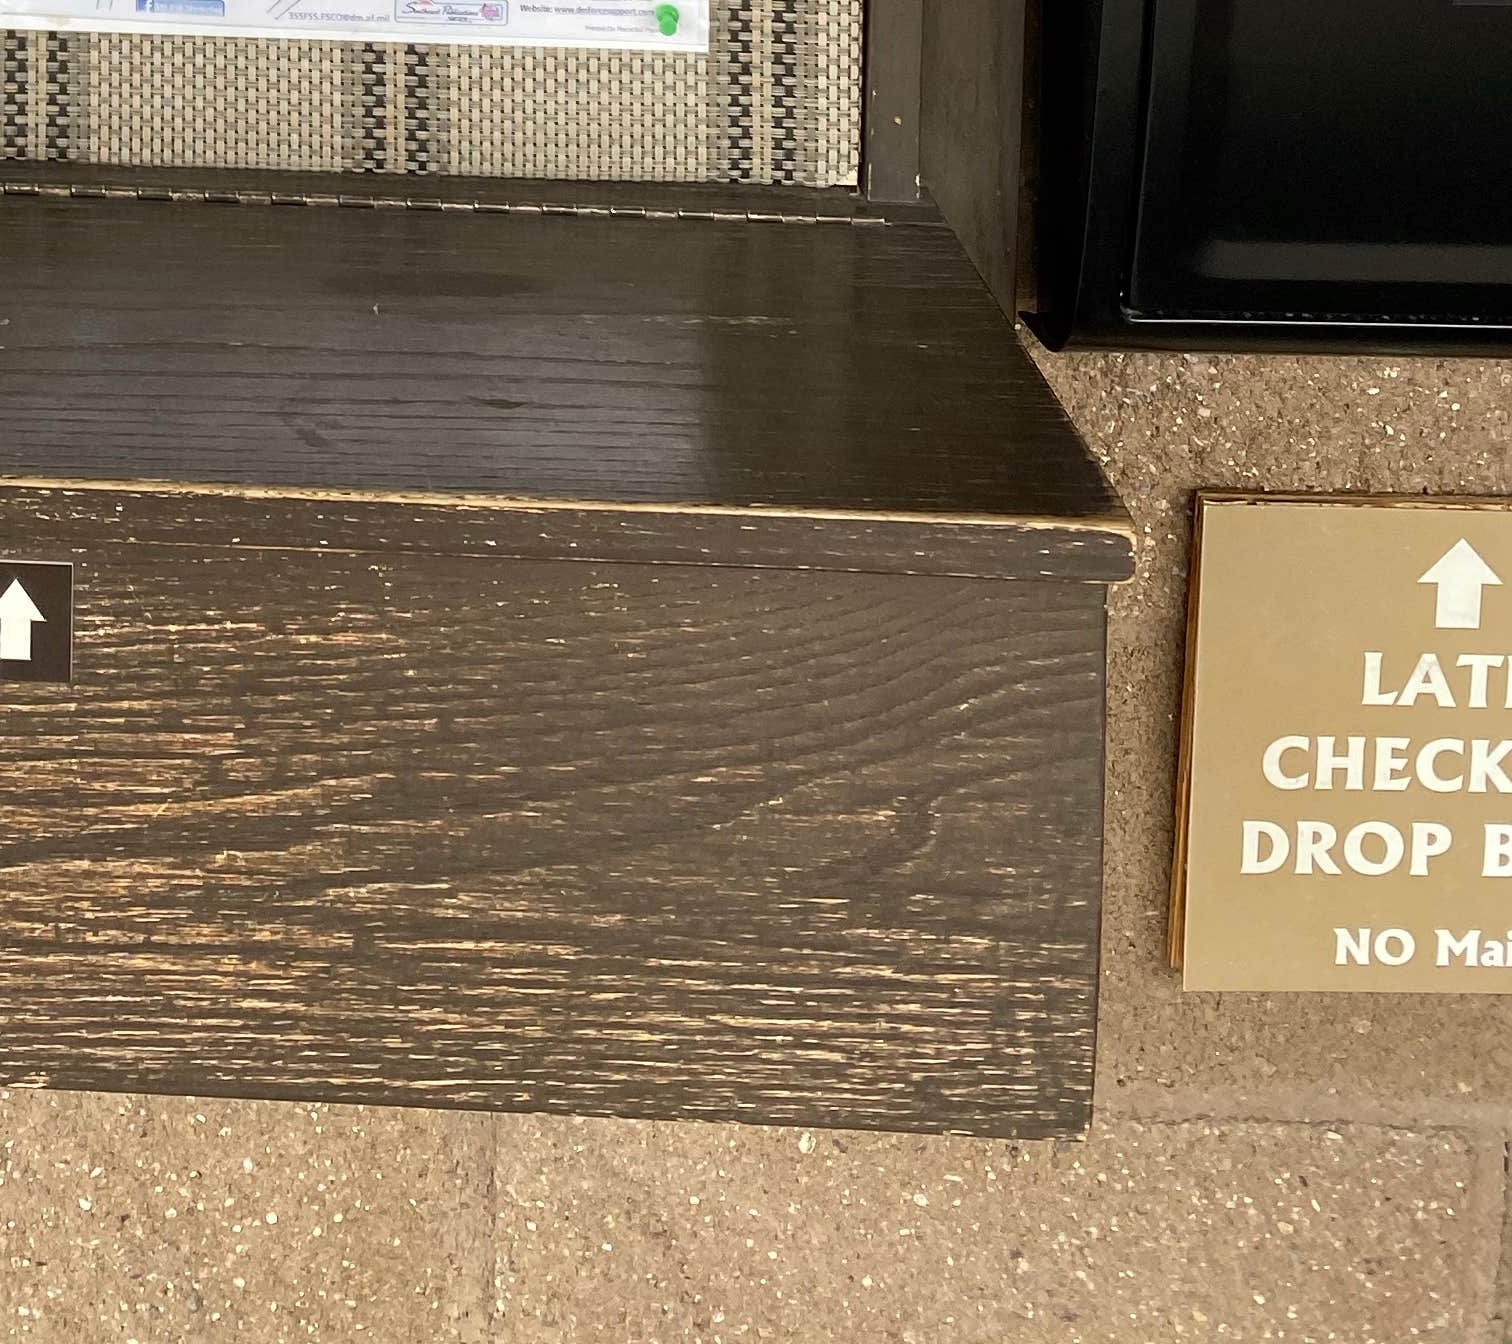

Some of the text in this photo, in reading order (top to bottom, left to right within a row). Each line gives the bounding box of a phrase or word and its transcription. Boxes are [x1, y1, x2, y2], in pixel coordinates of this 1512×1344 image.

[1361, 651, 1512, 709] LAT
[1240, 820, 1452, 877] DROP
[1333, 927, 1415, 966] NO
